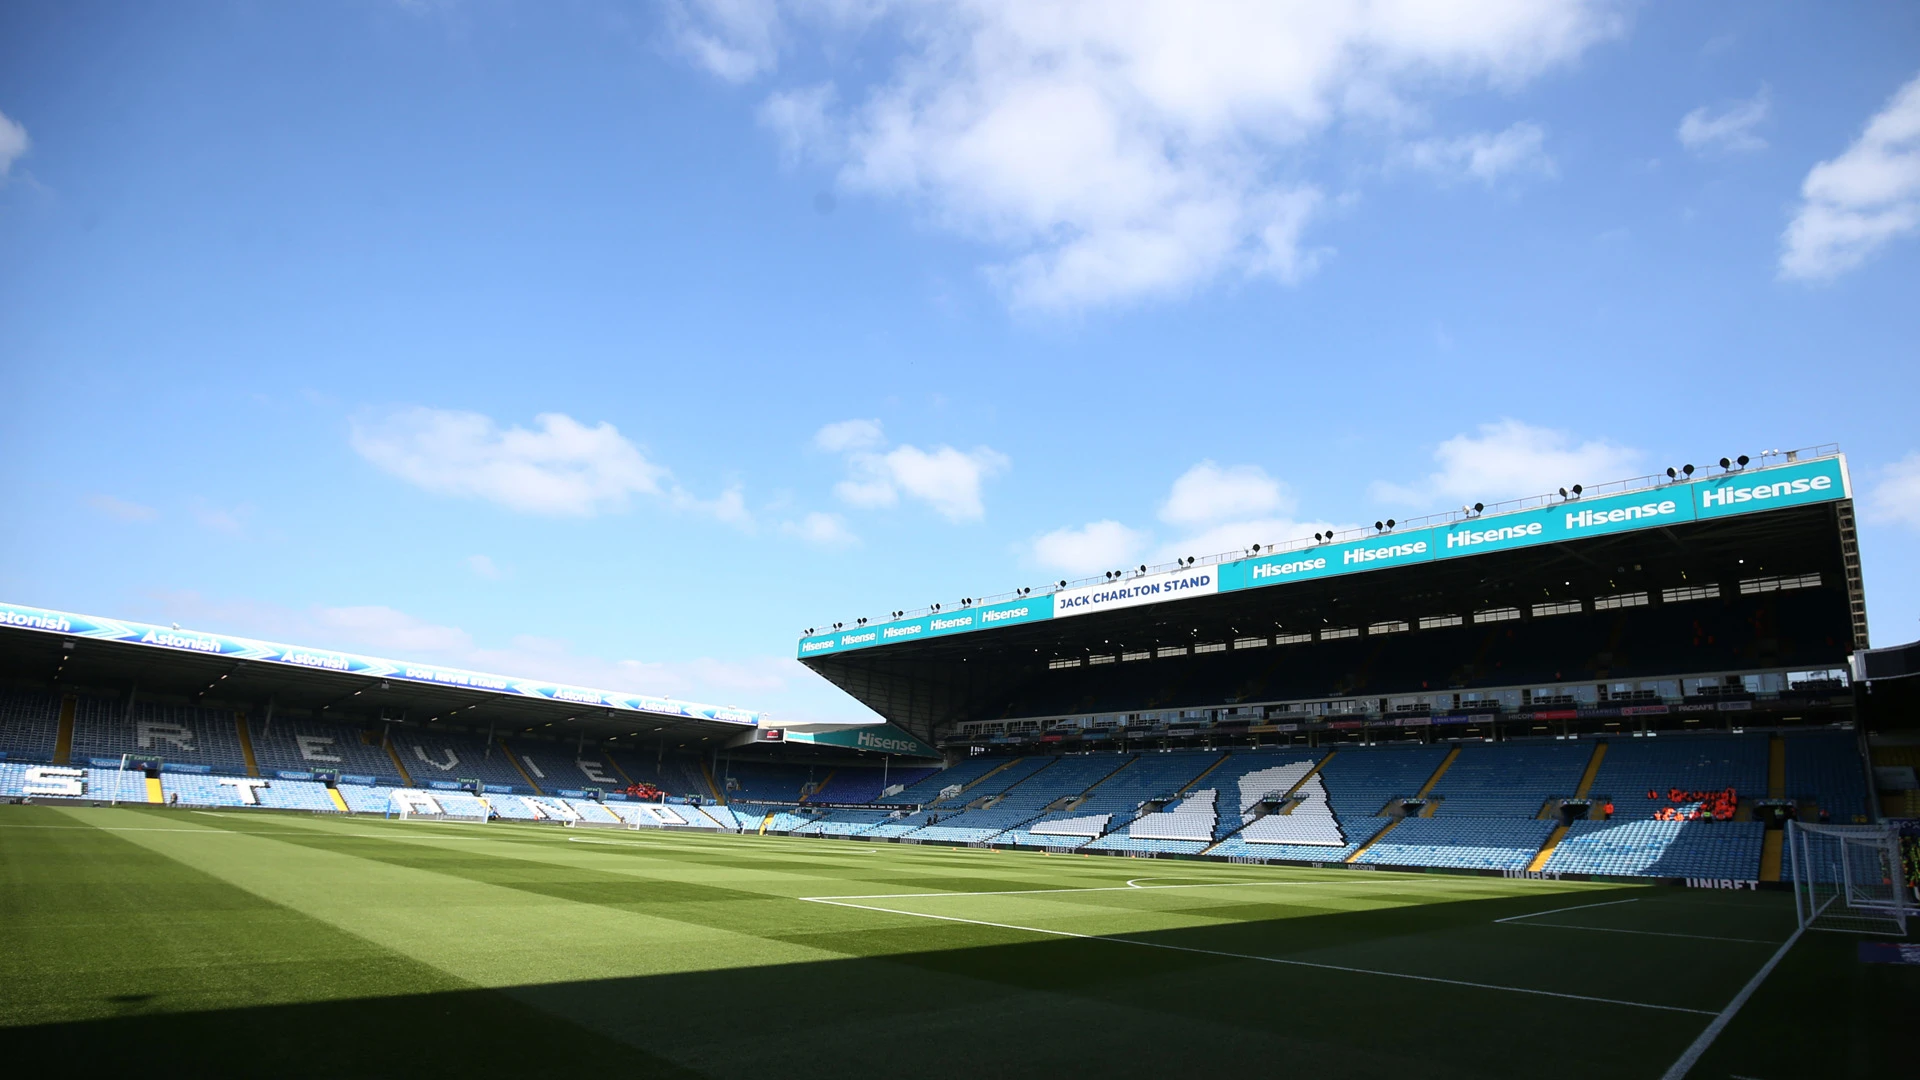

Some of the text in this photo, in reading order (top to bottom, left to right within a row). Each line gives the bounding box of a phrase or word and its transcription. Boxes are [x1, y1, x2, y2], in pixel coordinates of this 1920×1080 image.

[1703, 476, 1832, 507] Hisense
[1566, 501, 1676, 529] Hisense
[1445, 522, 1543, 549] Hisense
[1344, 540, 1427, 564] Hisense
[1252, 557, 1326, 579] Hisense
[1060, 575, 1211, 609] JACK CHARLTON STAND
[982, 606, 1029, 623] Hisense
[883, 623, 922, 639] Hisense
[930, 616, 973, 631] Hisense
[141, 630, 221, 652] Astonish
[802, 639, 835, 652] Hisense
[841, 632, 876, 646] Hisense
[280, 650, 349, 670] Astonish
[553, 688, 602, 704] Astonish
[638, 698, 681, 714] Astonish
[858, 731, 917, 752] Hisense
[1045, 845, 1076, 855] UNIBET
[1228, 857, 1268, 866] UNIBET
[1503, 870, 1561, 880] UNIBET
[1686, 878, 1759, 890] UNIBET
